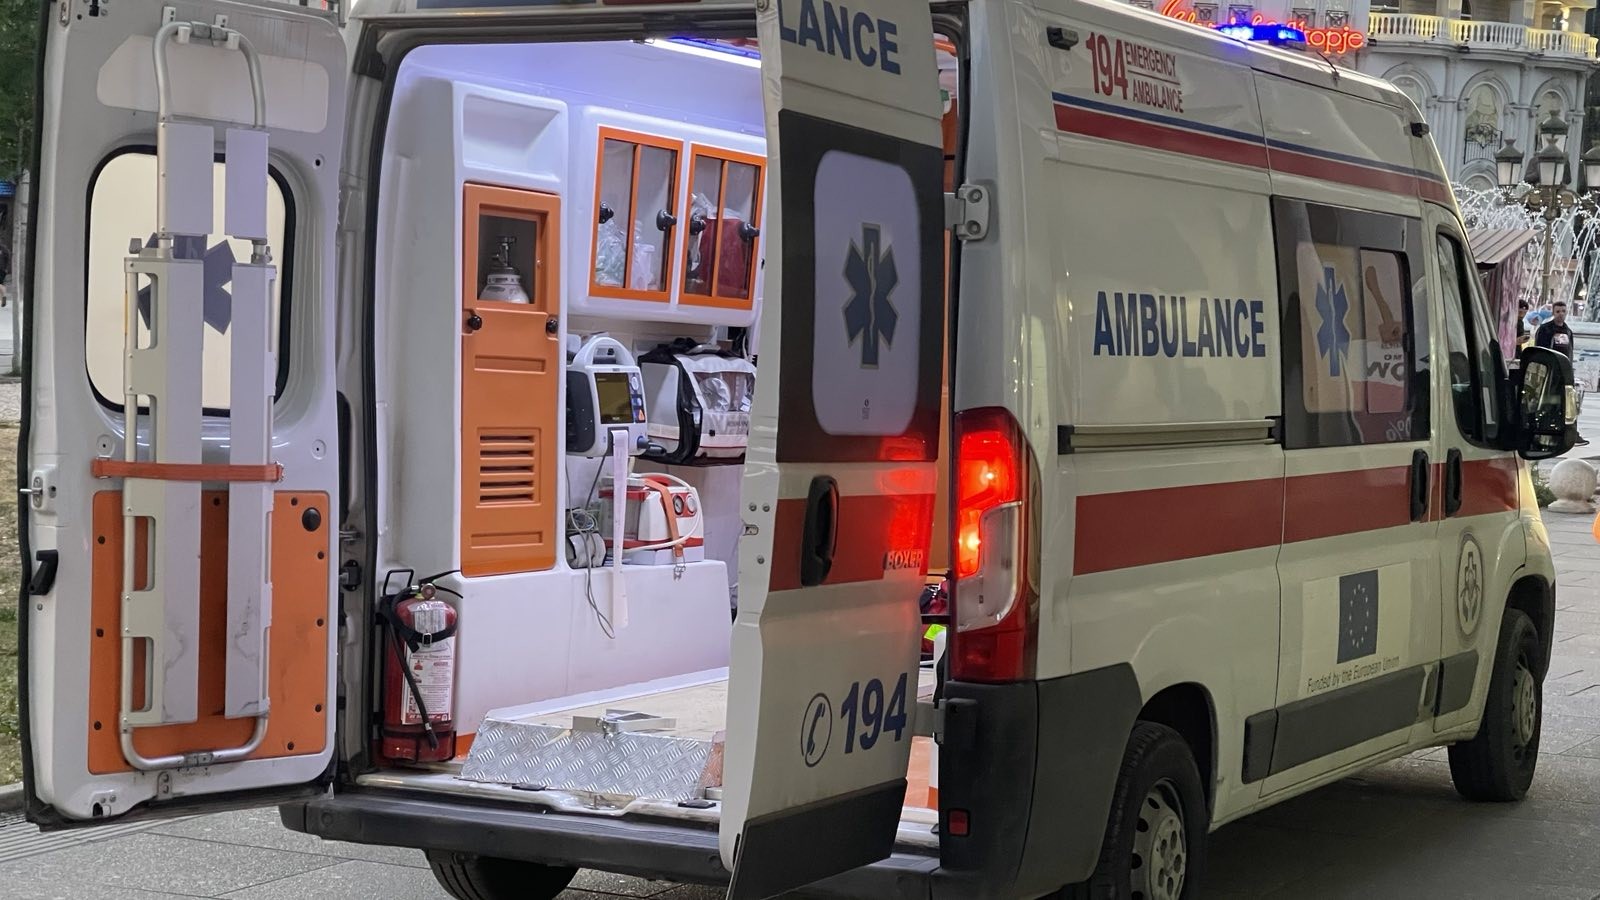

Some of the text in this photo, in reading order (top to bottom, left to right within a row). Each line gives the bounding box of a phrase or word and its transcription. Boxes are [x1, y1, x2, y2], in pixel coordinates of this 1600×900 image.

[777, 0, 901, 75] LANCE
[1124, 42, 1176, 77] EMERGENCY
[1086, 31, 1128, 100] 194
[1132, 79, 1184, 113] AMBULANCE
[1093, 290, 1266, 358] AMBULANCE
[882, 548, 923, 571] BOXER
[1307, 656, 1400, 694] Funded by the European Union
[840, 672, 908, 754] 194
